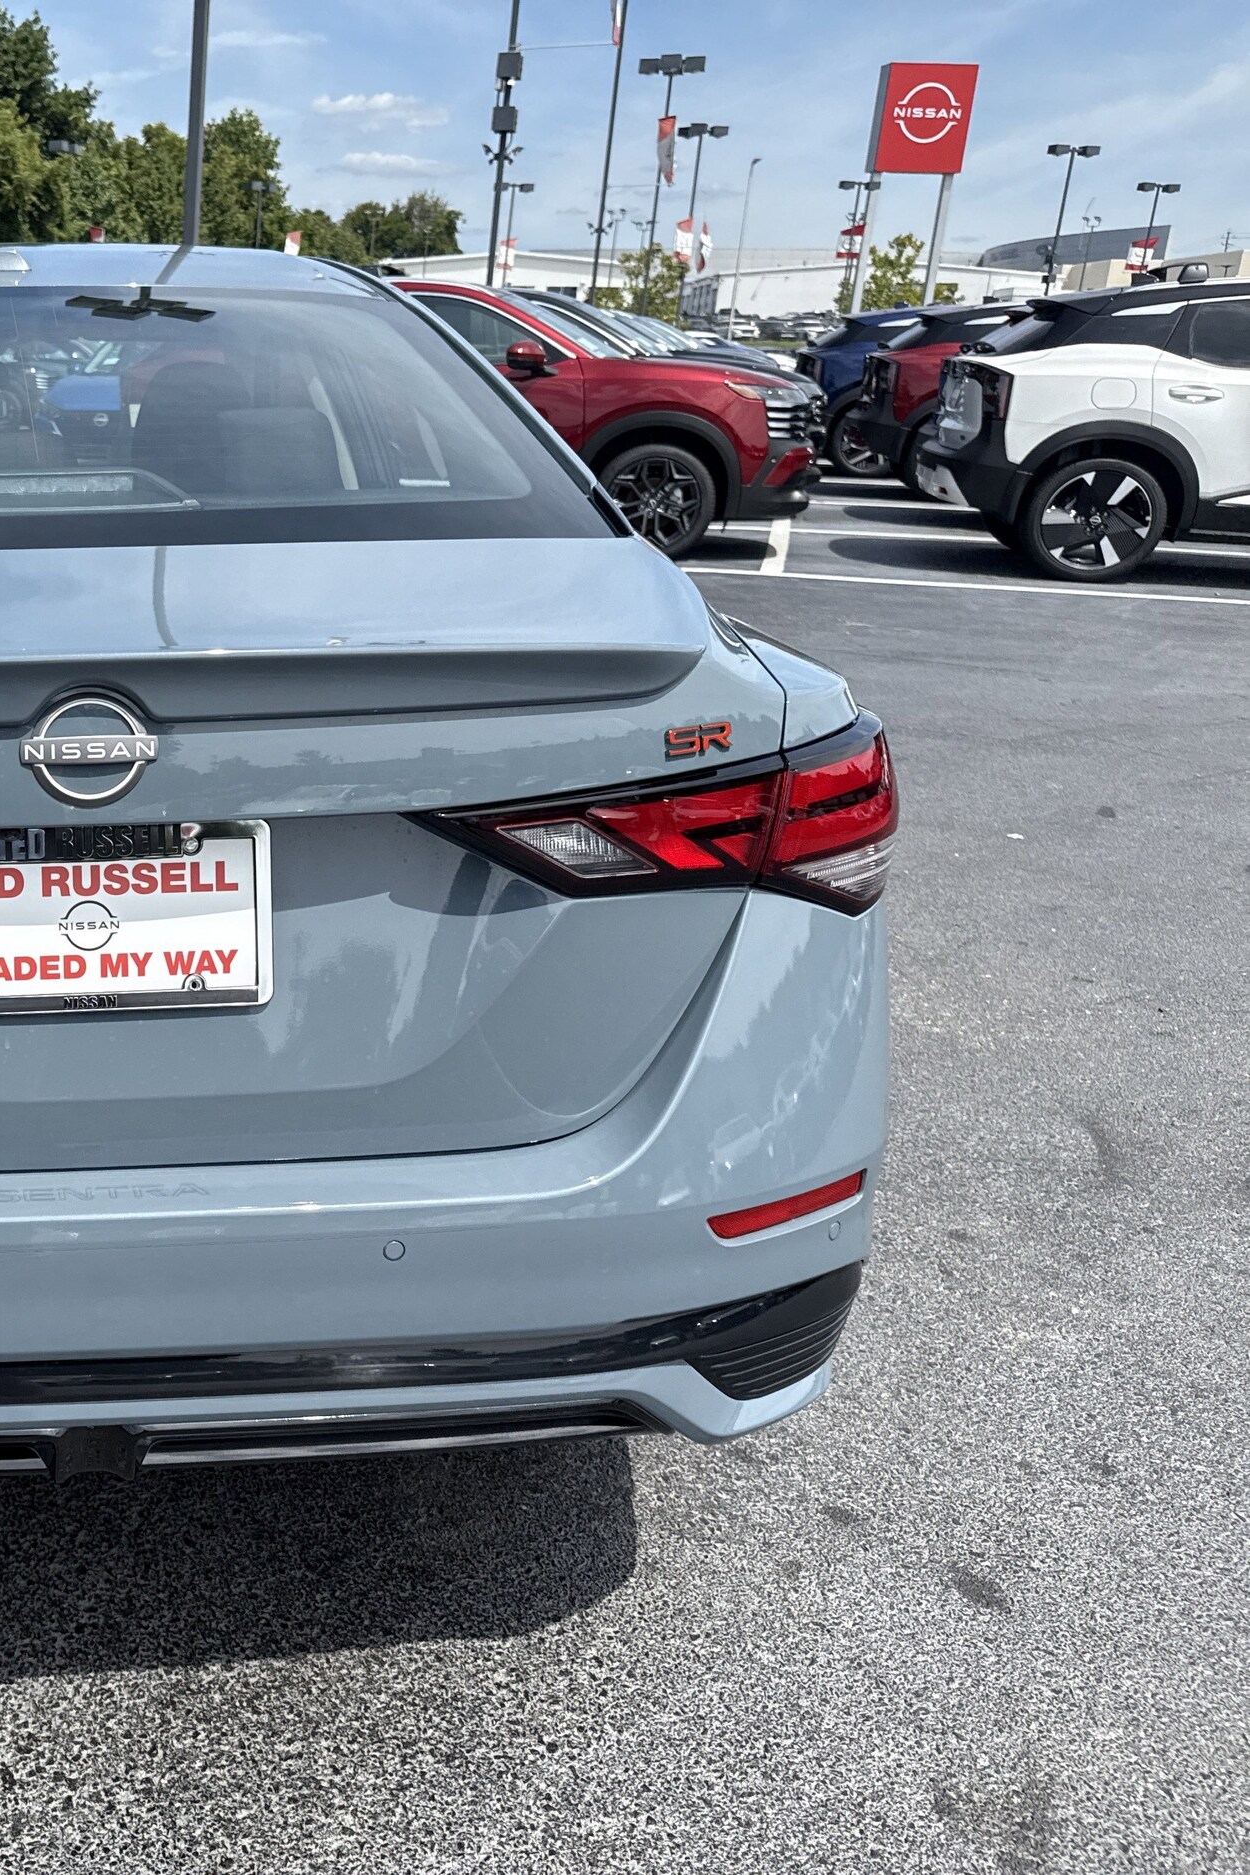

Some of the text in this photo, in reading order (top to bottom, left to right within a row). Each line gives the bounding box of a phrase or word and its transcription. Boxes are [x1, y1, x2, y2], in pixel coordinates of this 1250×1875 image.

[893, 106, 962, 119] NISSAN
[24, 740, 155, 760] NISSAN
[666, 721, 733, 757] SR
[55, 824, 179, 859] RUSSELL
[41, 861, 239, 897] RUSSELL
[58, 920, 121, 932] NISSAN
[100, 953, 153, 977] MY
[163, 949, 239, 974] WAY
[63, 995, 118, 1009] NISSAN
